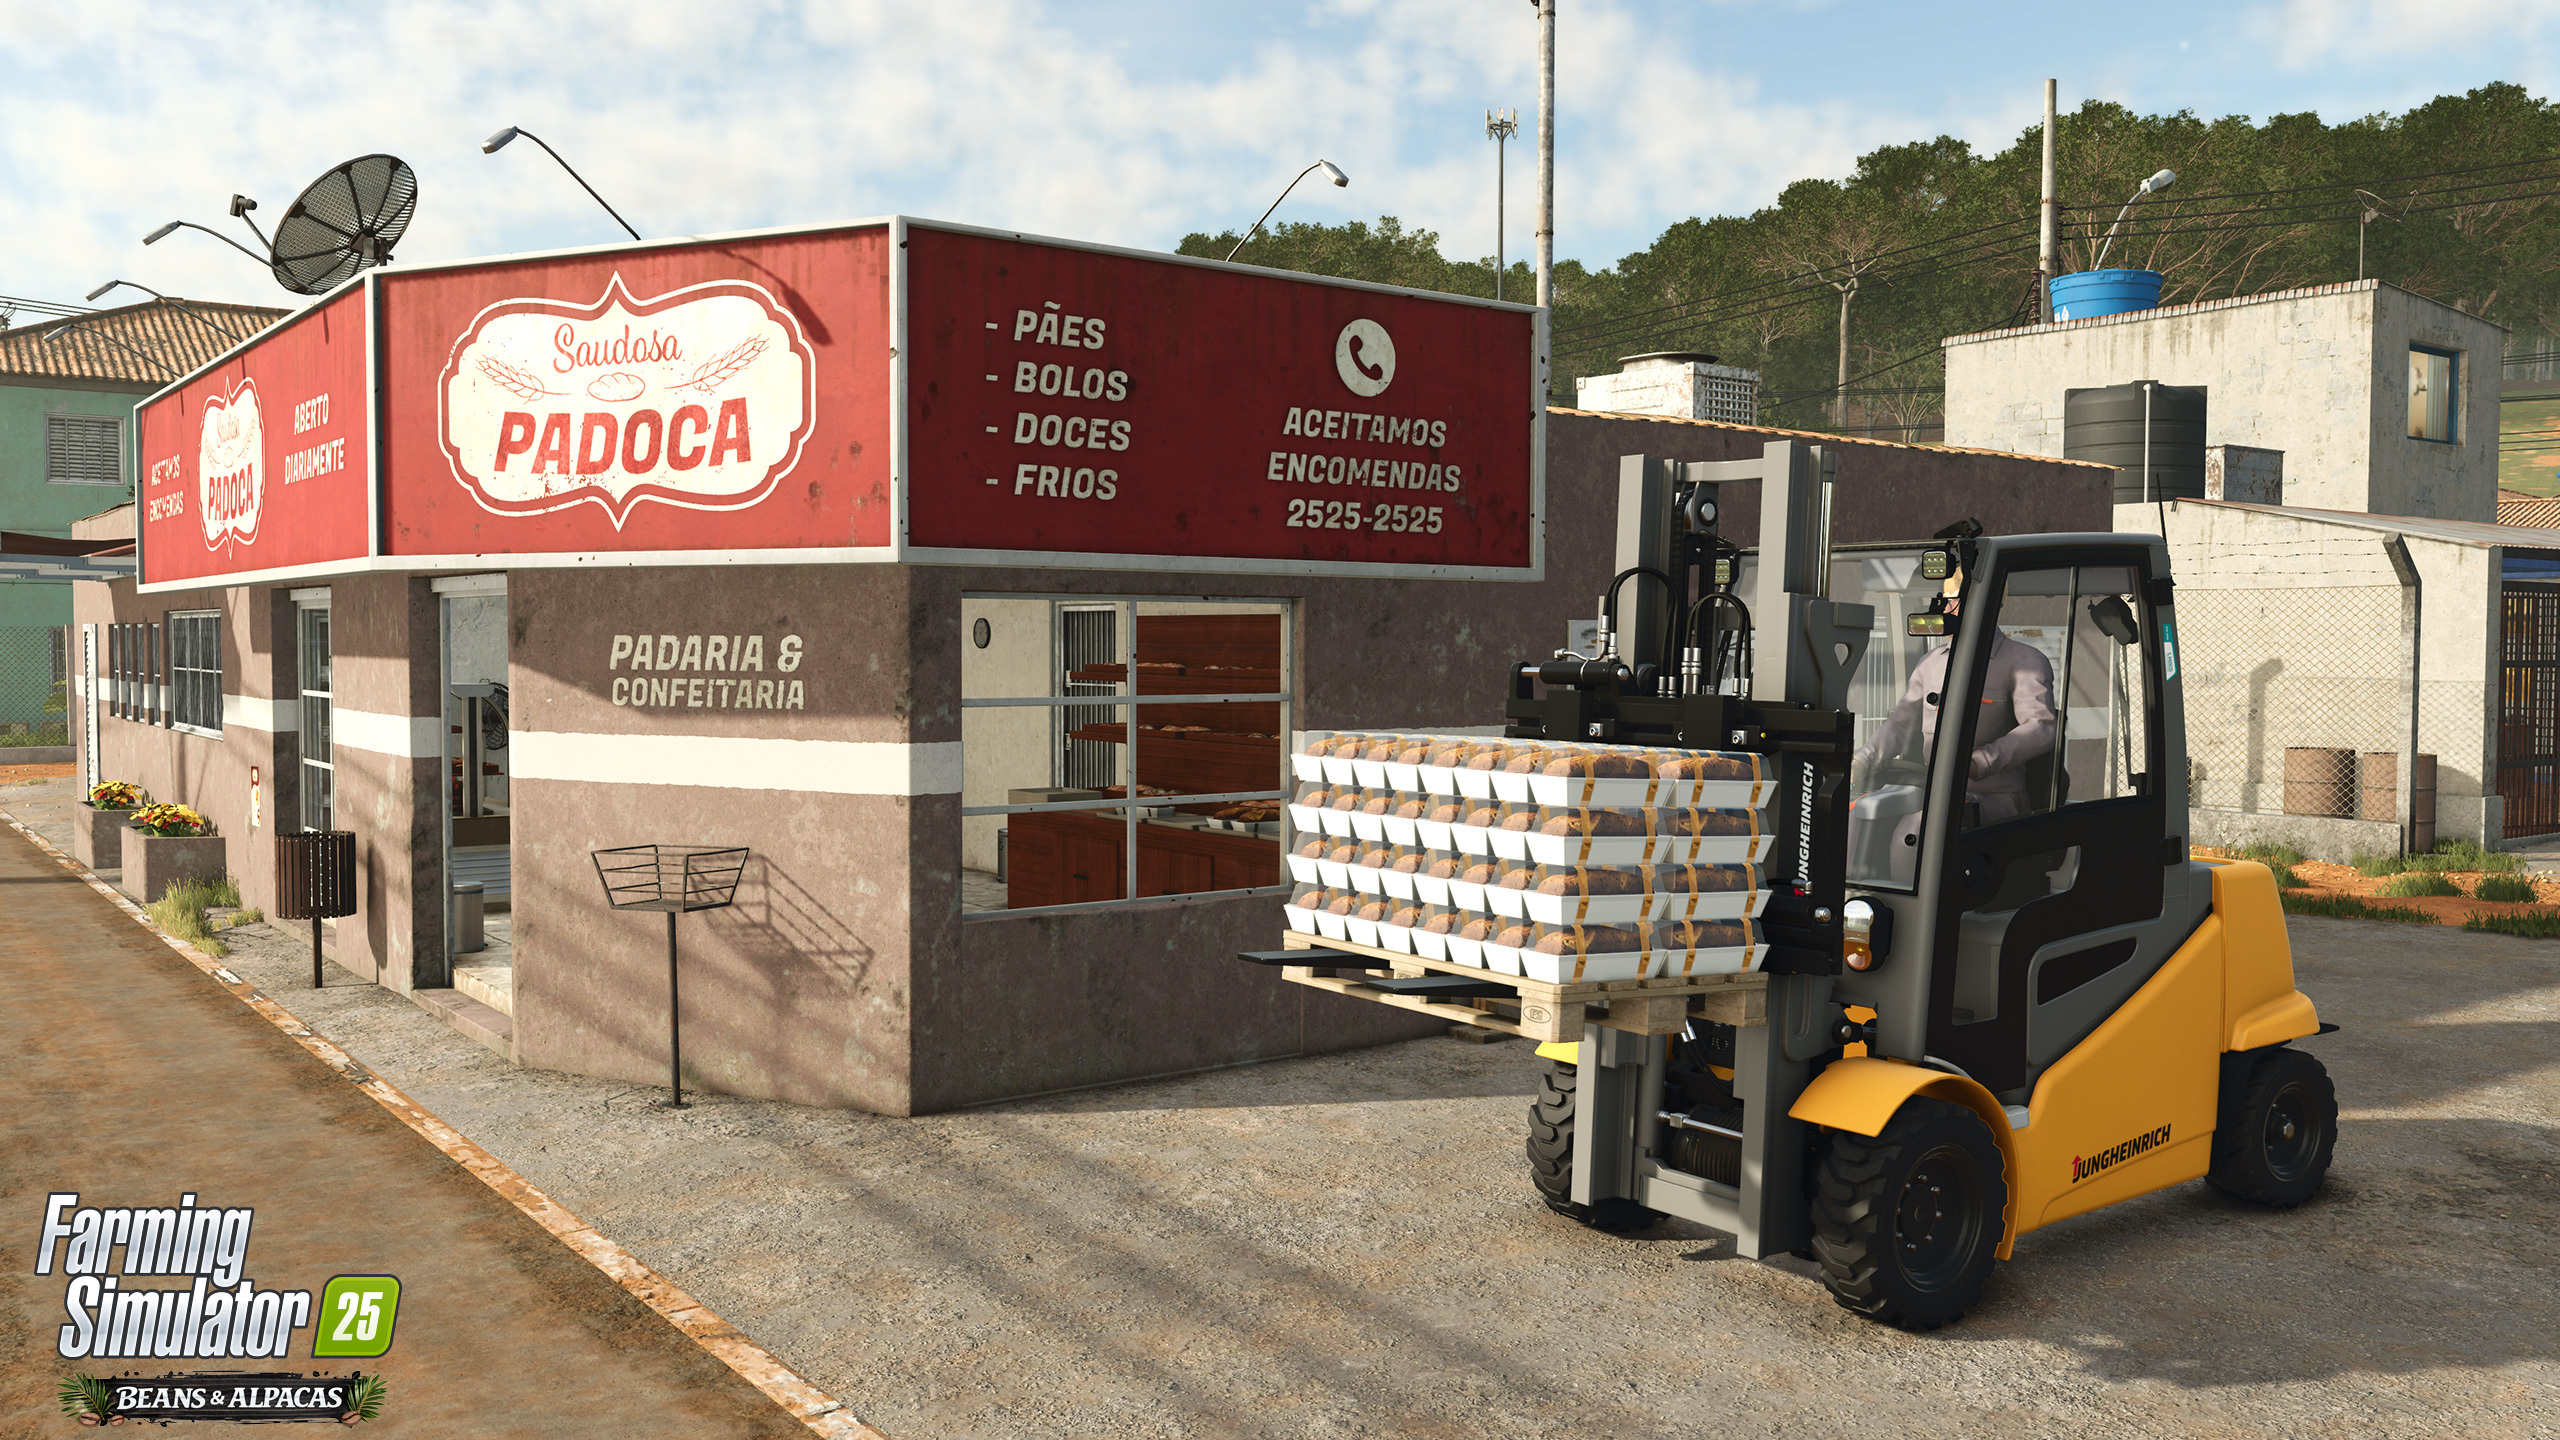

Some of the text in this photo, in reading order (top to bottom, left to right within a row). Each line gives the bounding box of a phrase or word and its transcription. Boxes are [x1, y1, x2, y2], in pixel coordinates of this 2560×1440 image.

[1013, 301, 1106, 350] PÃES
[553, 323, 682, 374] Saudosa
[1013, 361, 1128, 402] BOLOS
[293, 392, 329, 435] ABERTO
[1013, 412, 1132, 451] DOCES
[1282, 406, 1447, 448] ACEITAMOS
[493, 397, 752, 475] PADOCA
[284, 437, 345, 485] DIARIAMENTE
[1013, 463, 1118, 501] FRIOS
[1266, 451, 1461, 493] ENCOMENDAS
[208, 462, 254, 520] PADOCA
[1286, 498, 1443, 534] 2525-2525
[609, 634, 804, 673] PADARIA &
[611, 677, 805, 710] CONFEITARIA
[2071, 1122, 2172, 1184] JUNGHEINRICH
